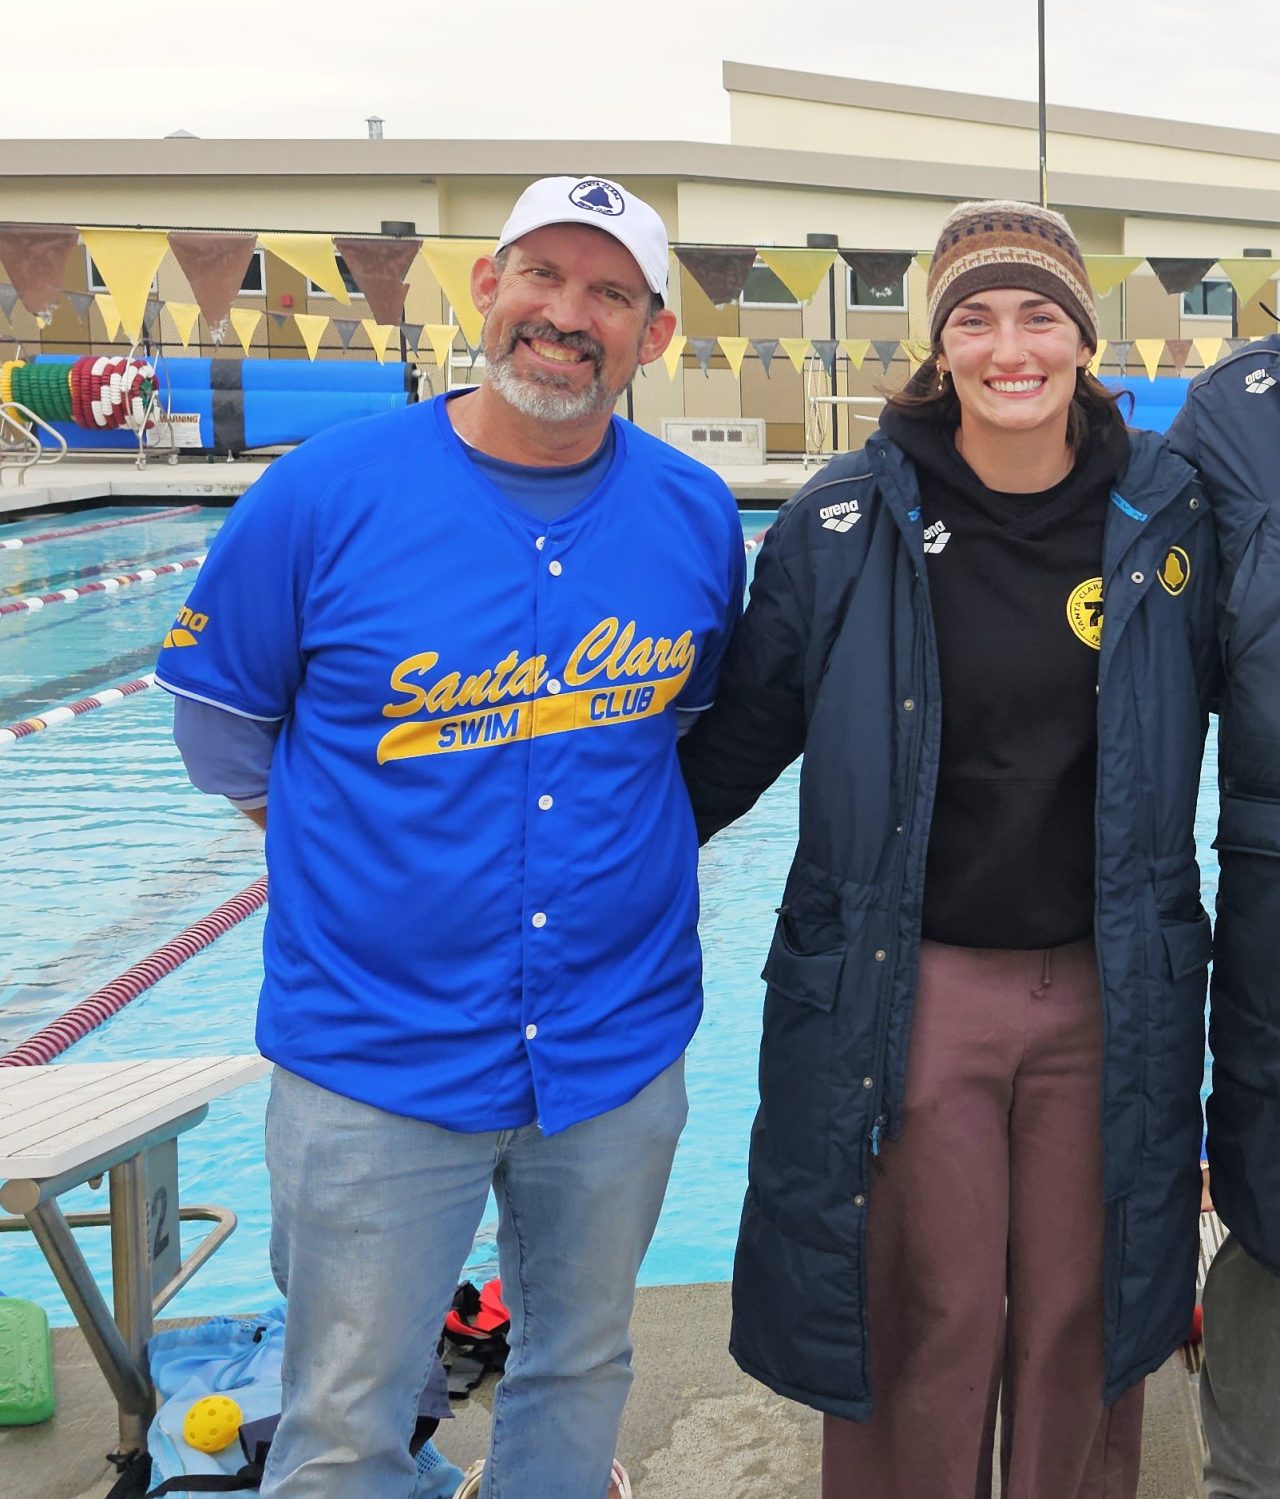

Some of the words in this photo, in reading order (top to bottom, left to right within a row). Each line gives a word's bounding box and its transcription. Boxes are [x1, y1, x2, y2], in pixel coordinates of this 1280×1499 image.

[819, 499, 859, 520] arena
[924, 520, 946, 540] ena
[1073, 601, 1086, 632] SANTA
[1084, 601, 1103, 627] 7
[381, 650, 551, 718] Santa
[562, 616, 695, 689] Clara
[437, 708, 521, 749] SWIM
[589, 685, 656, 721] CLUB
[151, 1186, 169, 1261] 2
